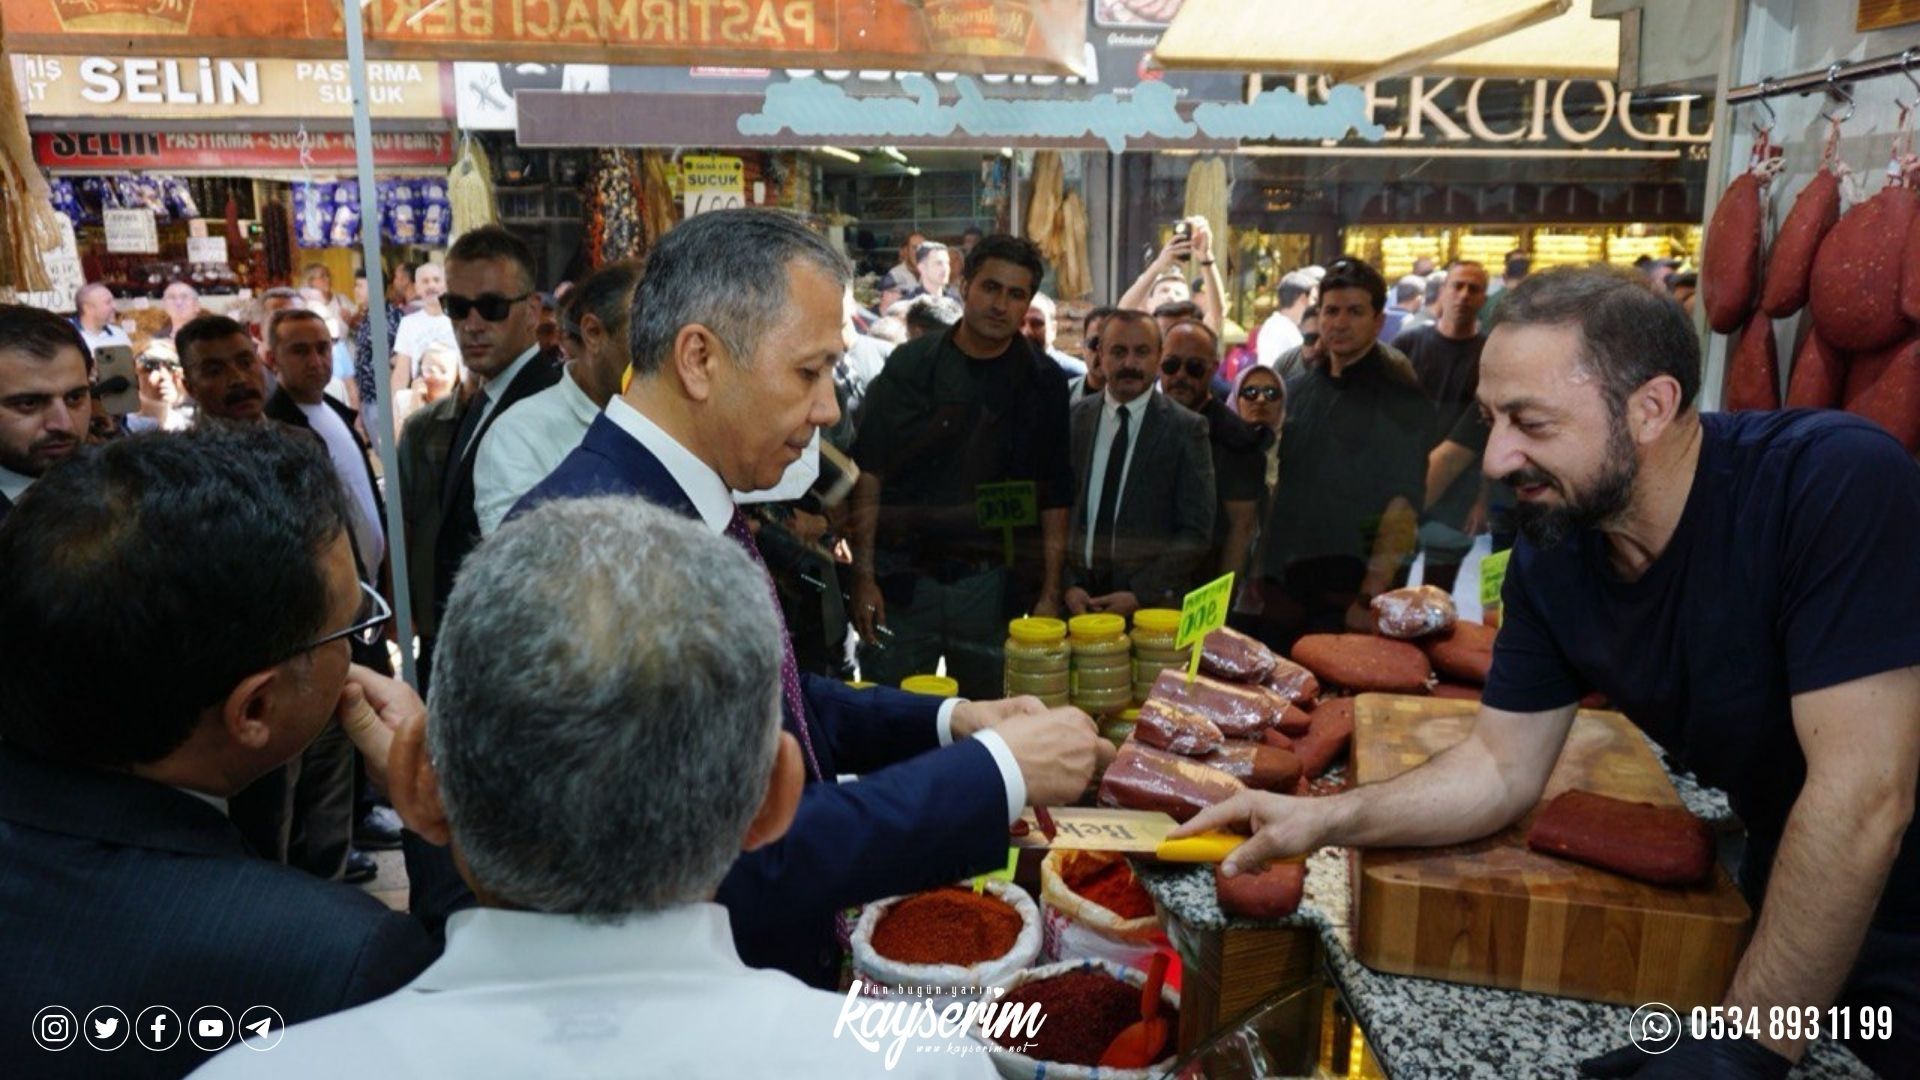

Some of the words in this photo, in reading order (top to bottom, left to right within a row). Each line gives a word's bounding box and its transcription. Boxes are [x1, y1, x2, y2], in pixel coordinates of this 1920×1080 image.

[80, 56, 262, 103] SELİN
[296, 62, 422, 82] PASRMA
[318, 84, 404, 104] SUUK
[687, 174, 739, 186] SUCUK
